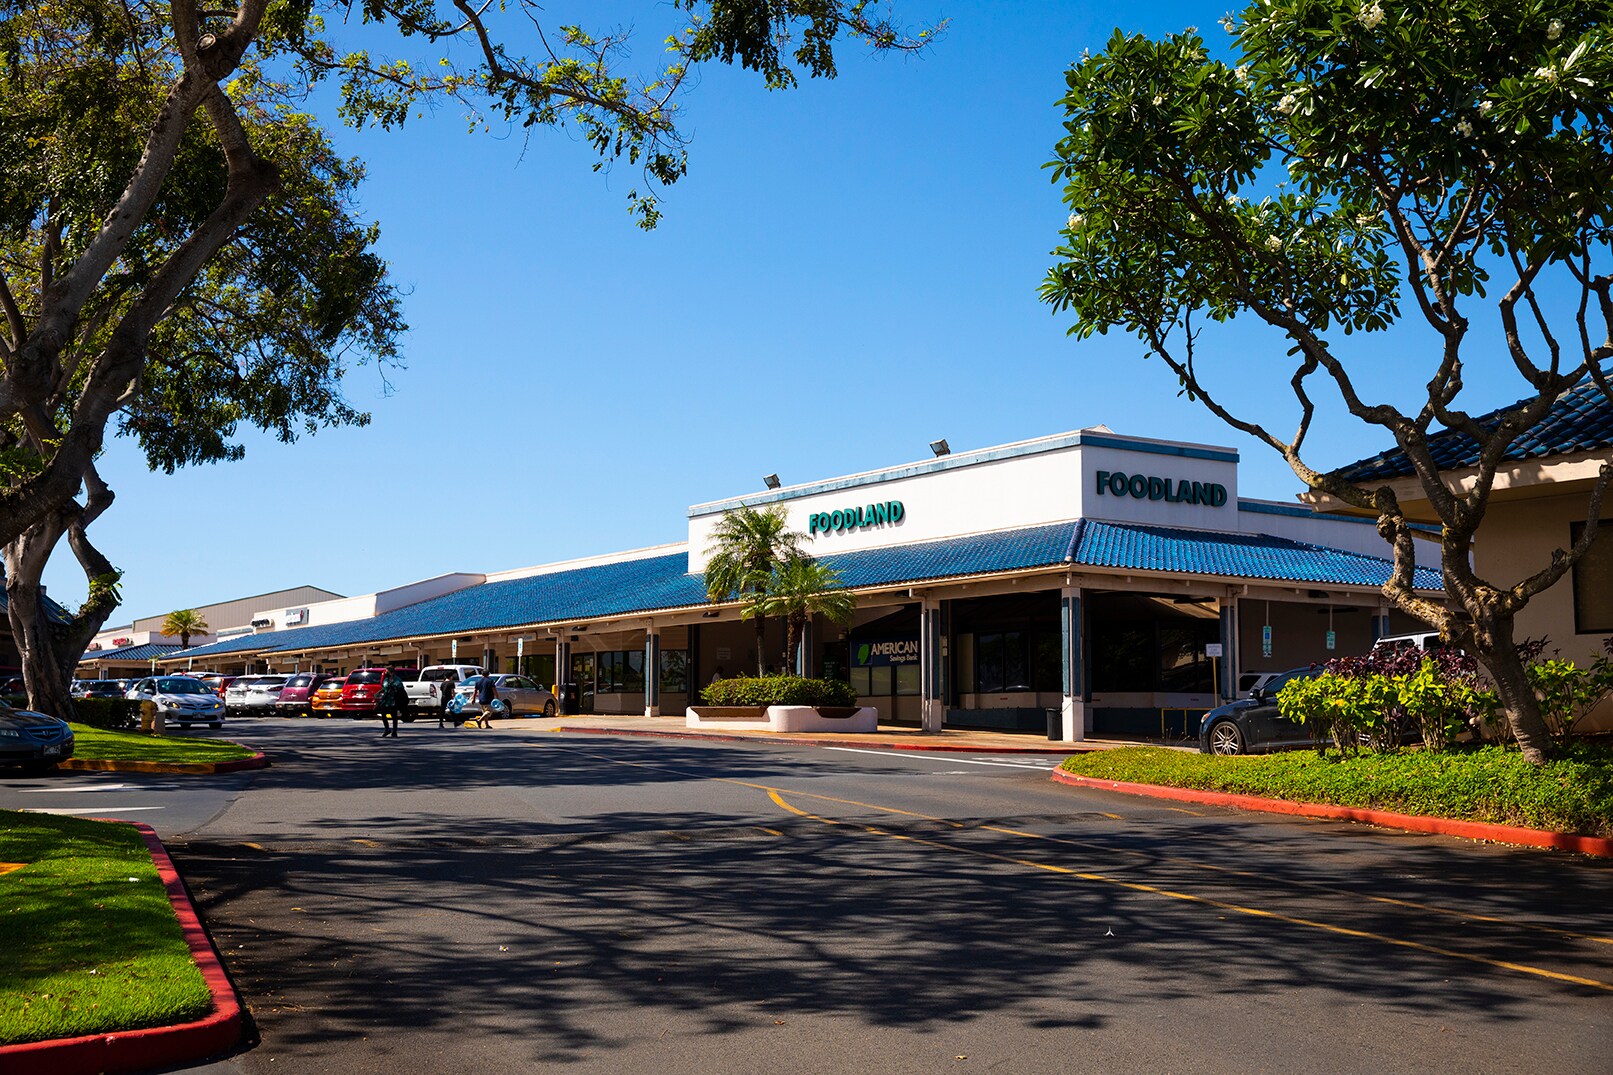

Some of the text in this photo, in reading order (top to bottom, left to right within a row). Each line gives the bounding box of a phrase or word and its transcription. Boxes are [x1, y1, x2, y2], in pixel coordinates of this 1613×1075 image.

[1096, 470, 1228, 507] FOODLAND
[809, 500, 905, 534] FOODLAND
[871, 640, 918, 655] AMERICAN
[889, 655, 906, 663] Savings
